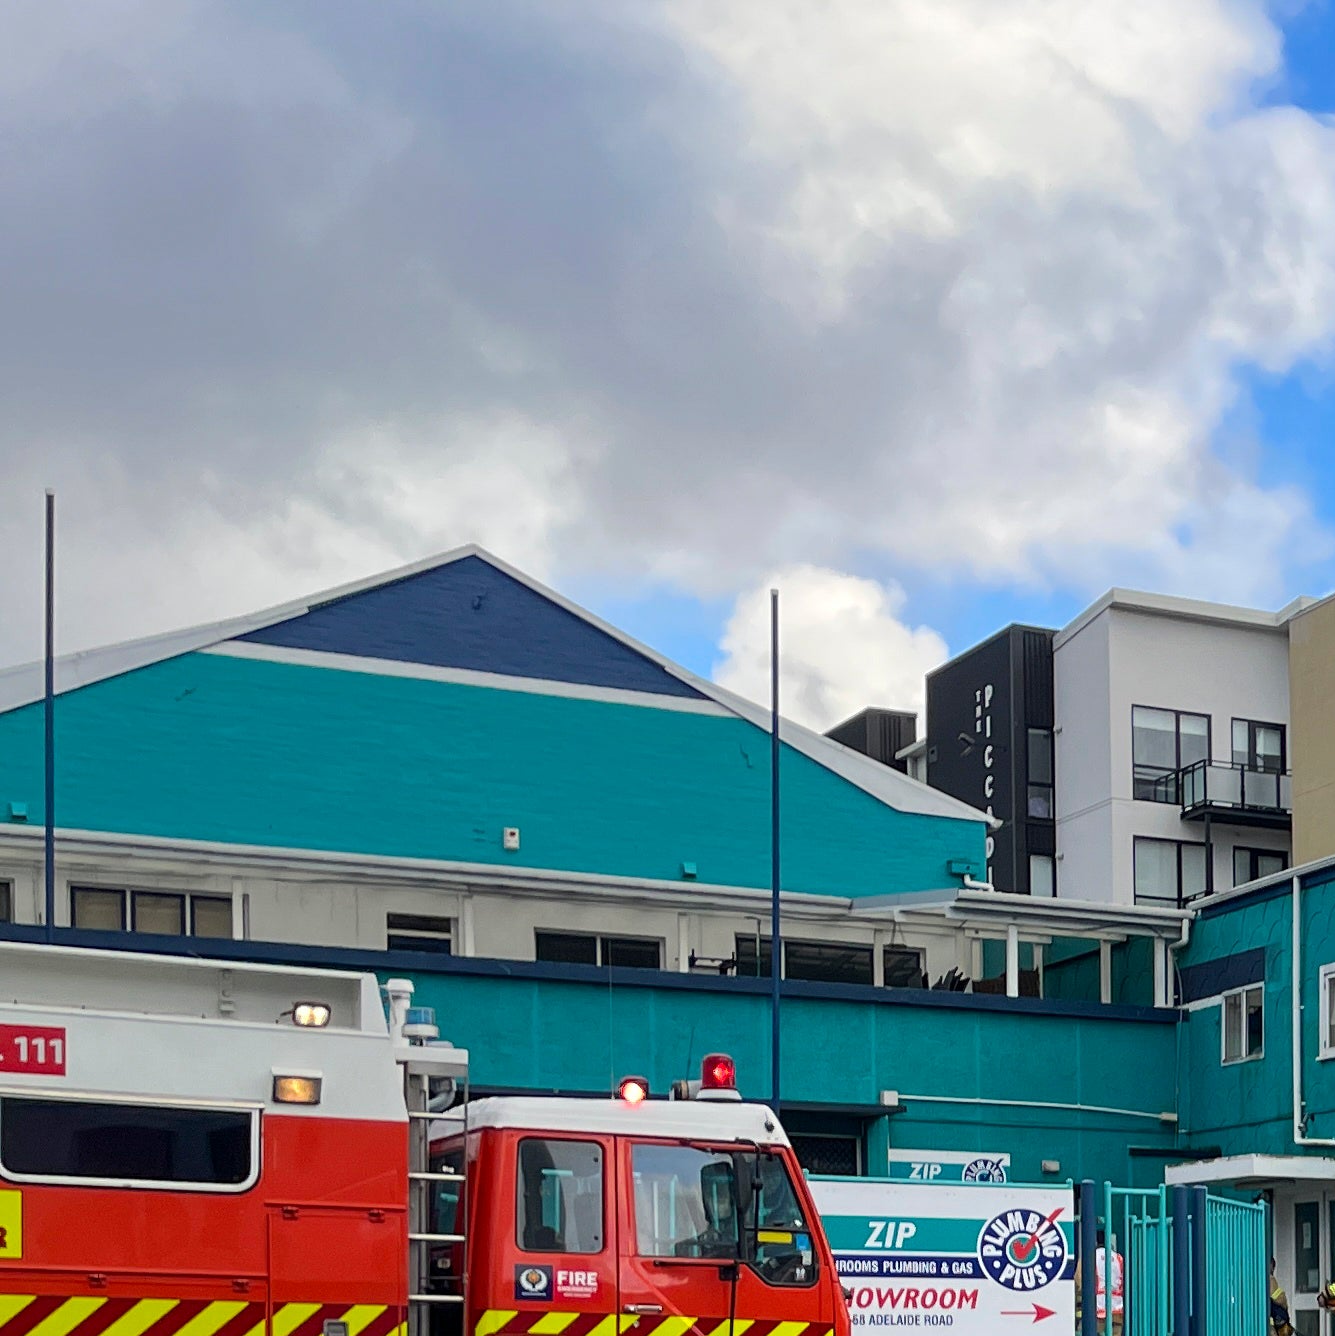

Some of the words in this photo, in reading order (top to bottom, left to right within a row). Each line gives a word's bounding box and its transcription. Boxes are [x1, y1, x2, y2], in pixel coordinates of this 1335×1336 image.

[14, 1035, 63, 1064] 111
[909, 1163, 942, 1180] ZIP
[864, 1221, 917, 1249] ZIP
[983, 1210, 1062, 1258] PLUMBING
[883, 1261, 937, 1274] PLUMBING
[941, 1262, 949, 1274] &
[952, 1262, 973, 1275] GAS
[557, 1270, 598, 1286] FIRE
[999, 1267, 1048, 1289] PLUS
[869, 1314, 920, 1326] ADELAIDE
[924, 1314, 953, 1326] ROAD
